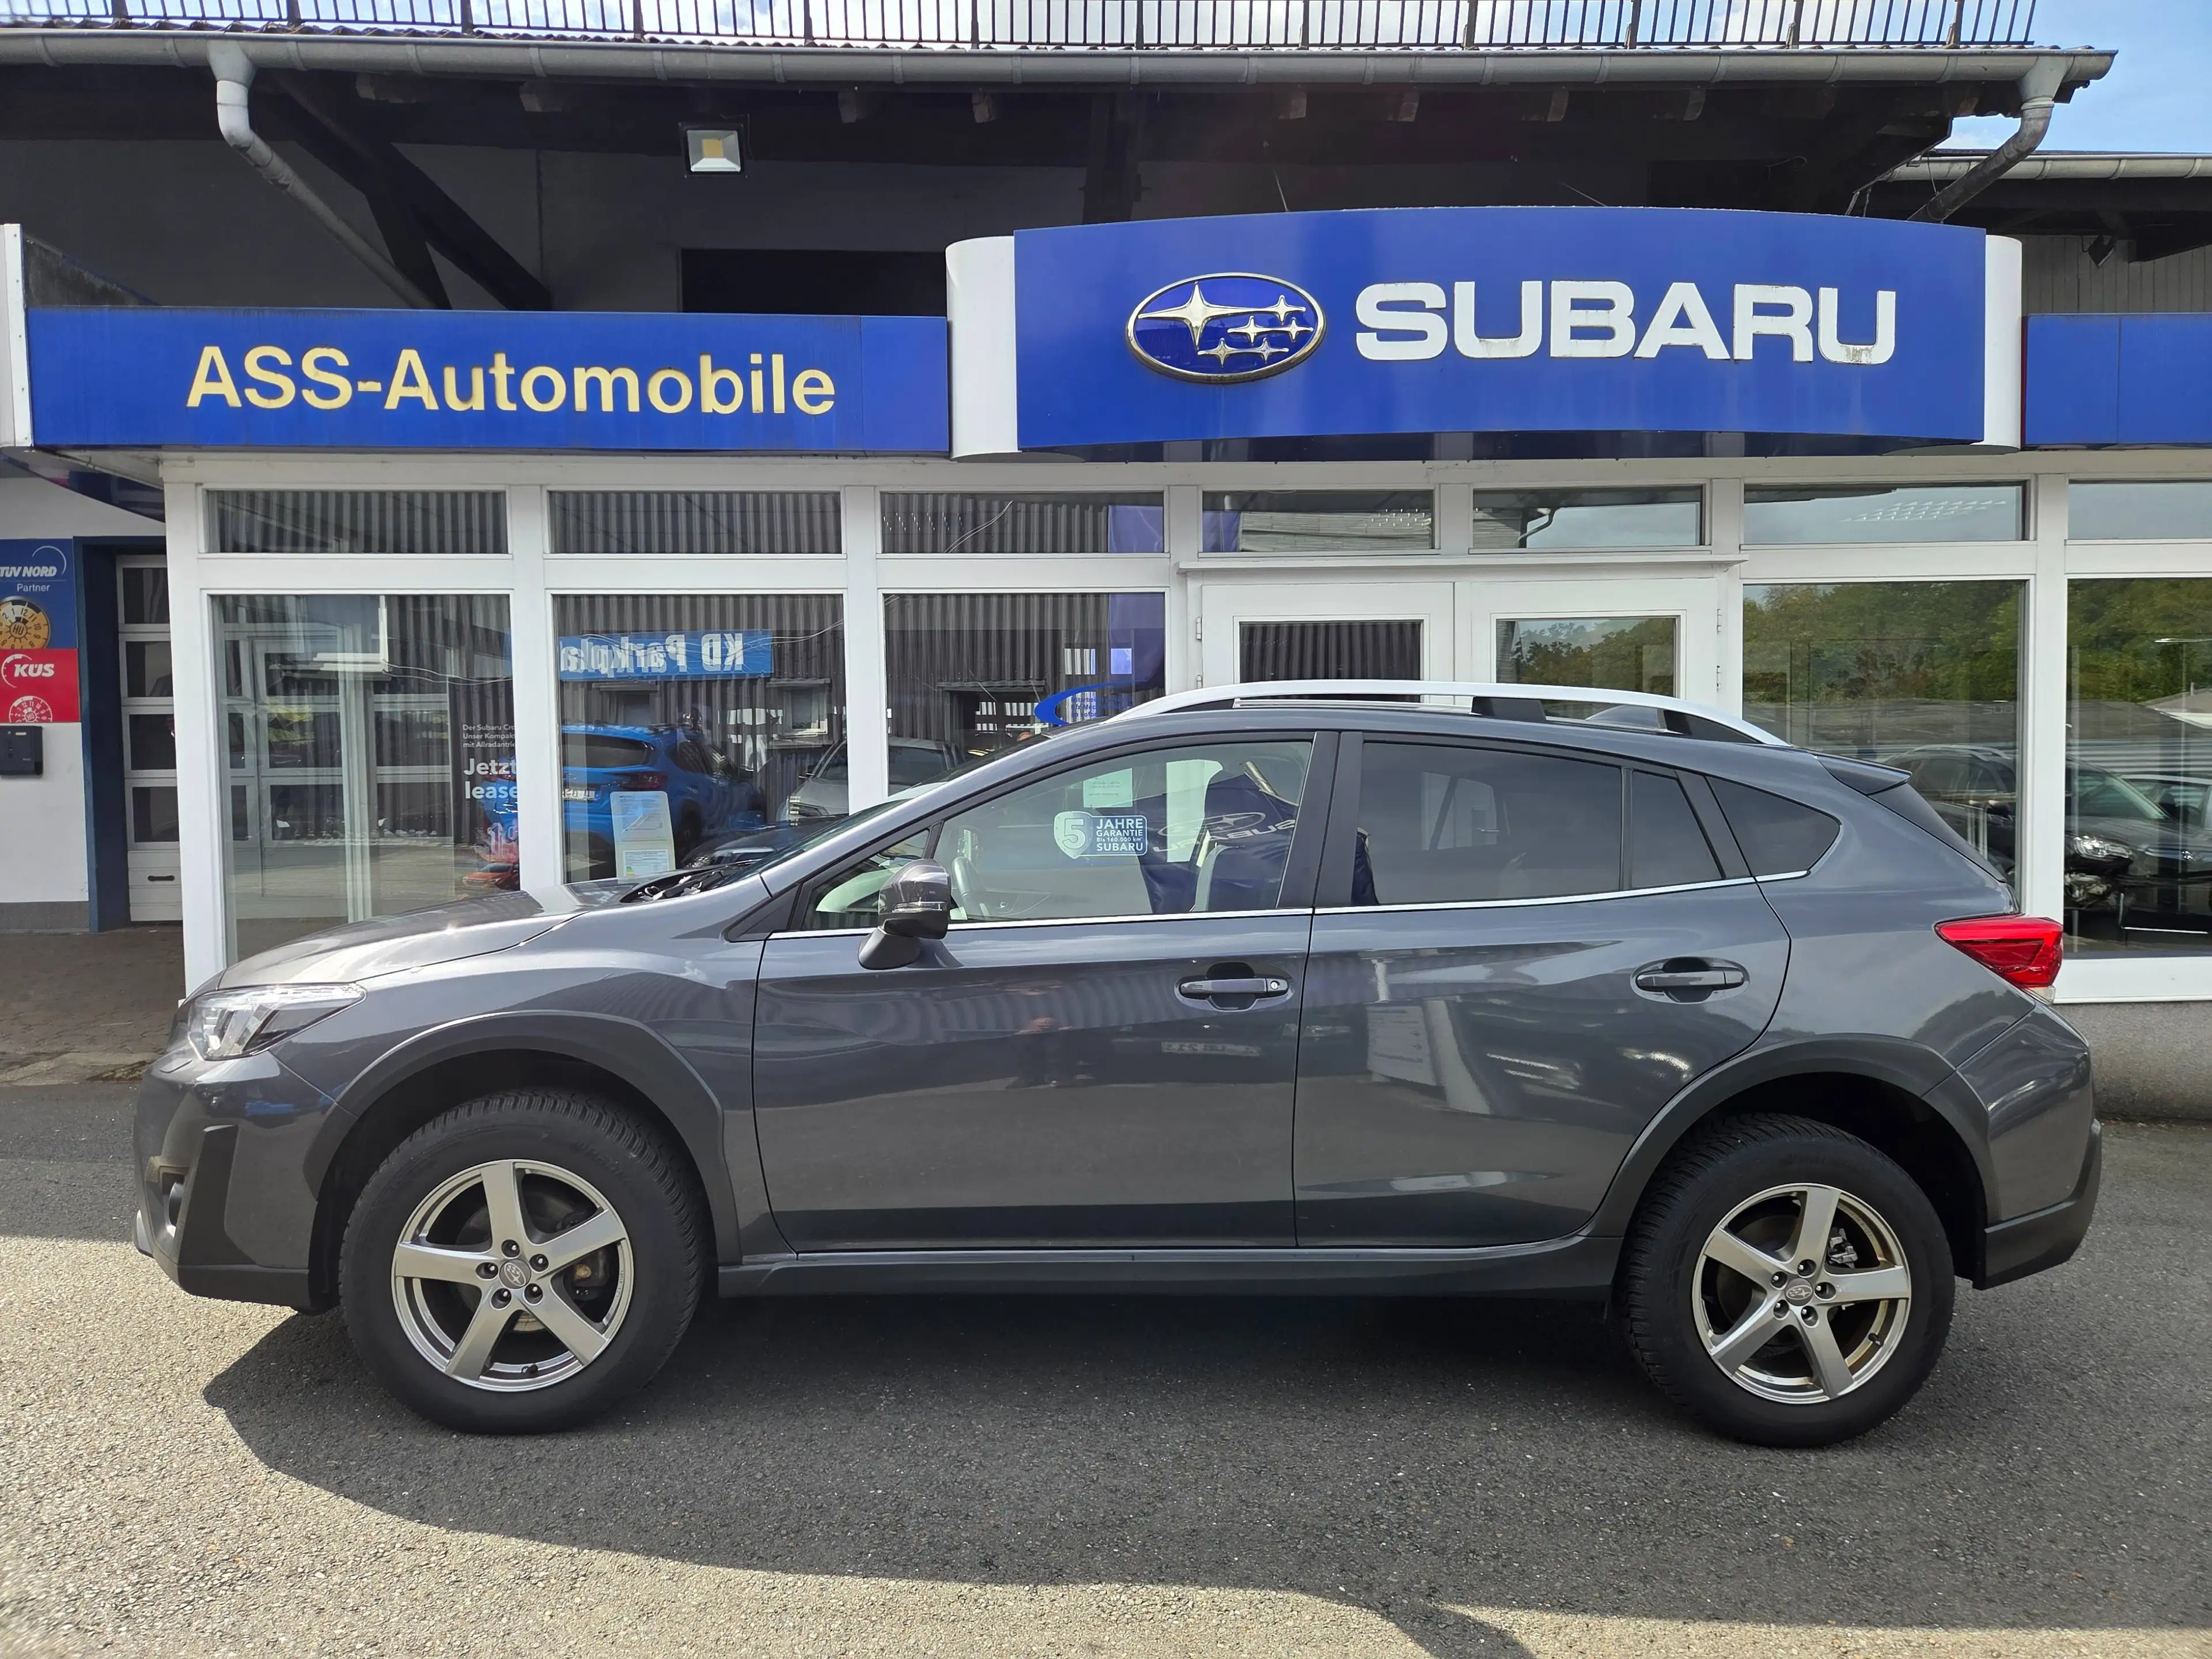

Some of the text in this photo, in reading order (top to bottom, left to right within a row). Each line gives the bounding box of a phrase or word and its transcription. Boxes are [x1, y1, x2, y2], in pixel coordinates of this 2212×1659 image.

[1354, 281, 1897, 365] SUBARU
[187, 346, 836, 415] ASS-Automobile
[22, 566, 57, 577] NORD
[17, 584, 50, 592] Partner
[13, 624, 24, 635] HU
[464, 758, 516, 775] Jetzt
[465, 781, 517, 799] lease
[1096, 818, 1143, 829] JAHRE
[1062, 818, 1086, 850] 5
[1097, 843, 1143, 851] SUBARU
